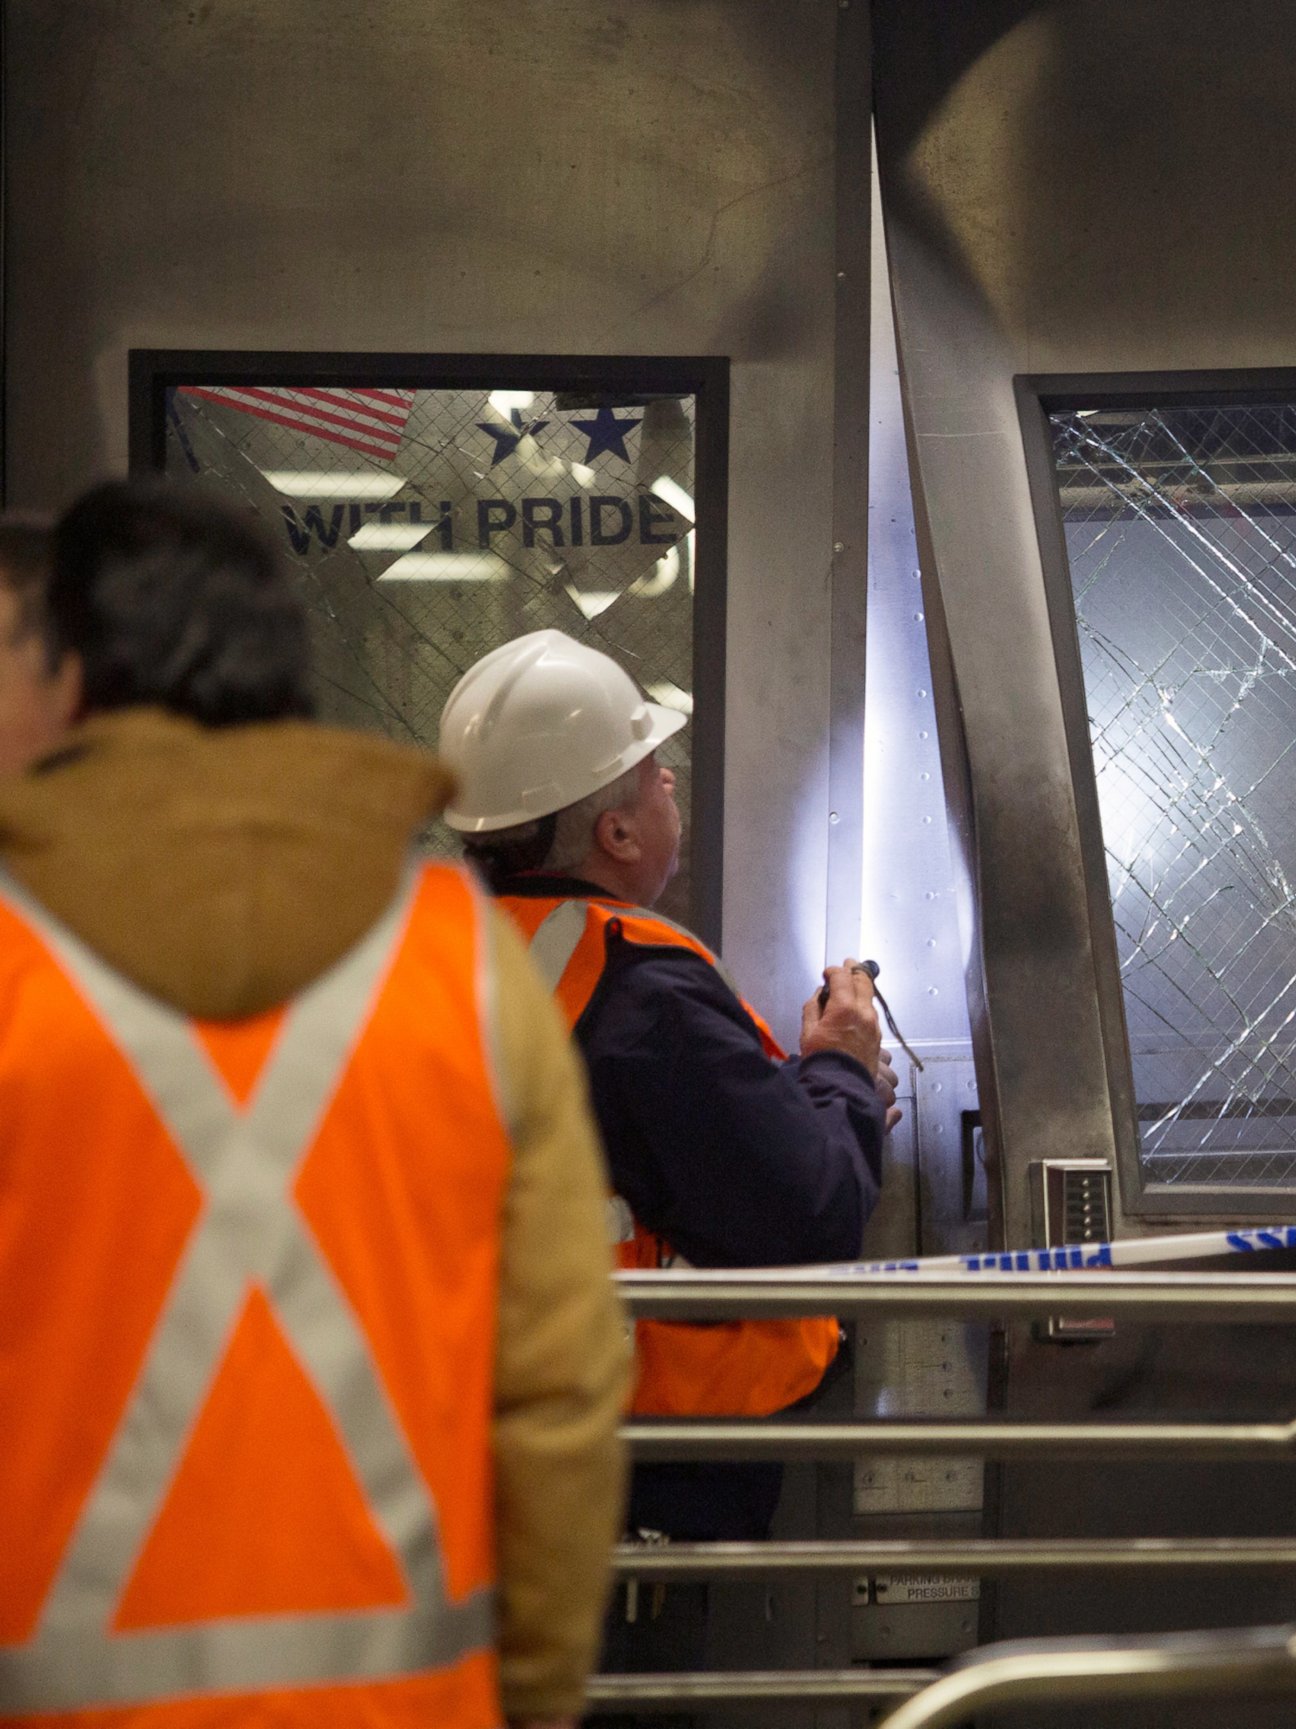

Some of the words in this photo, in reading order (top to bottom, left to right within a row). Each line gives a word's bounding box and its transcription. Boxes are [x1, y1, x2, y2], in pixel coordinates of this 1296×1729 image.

[281, 501, 453, 555] WITH
[477, 495, 678, 549] PRIDE
[907, 1586, 969, 1599] PRESSURE
